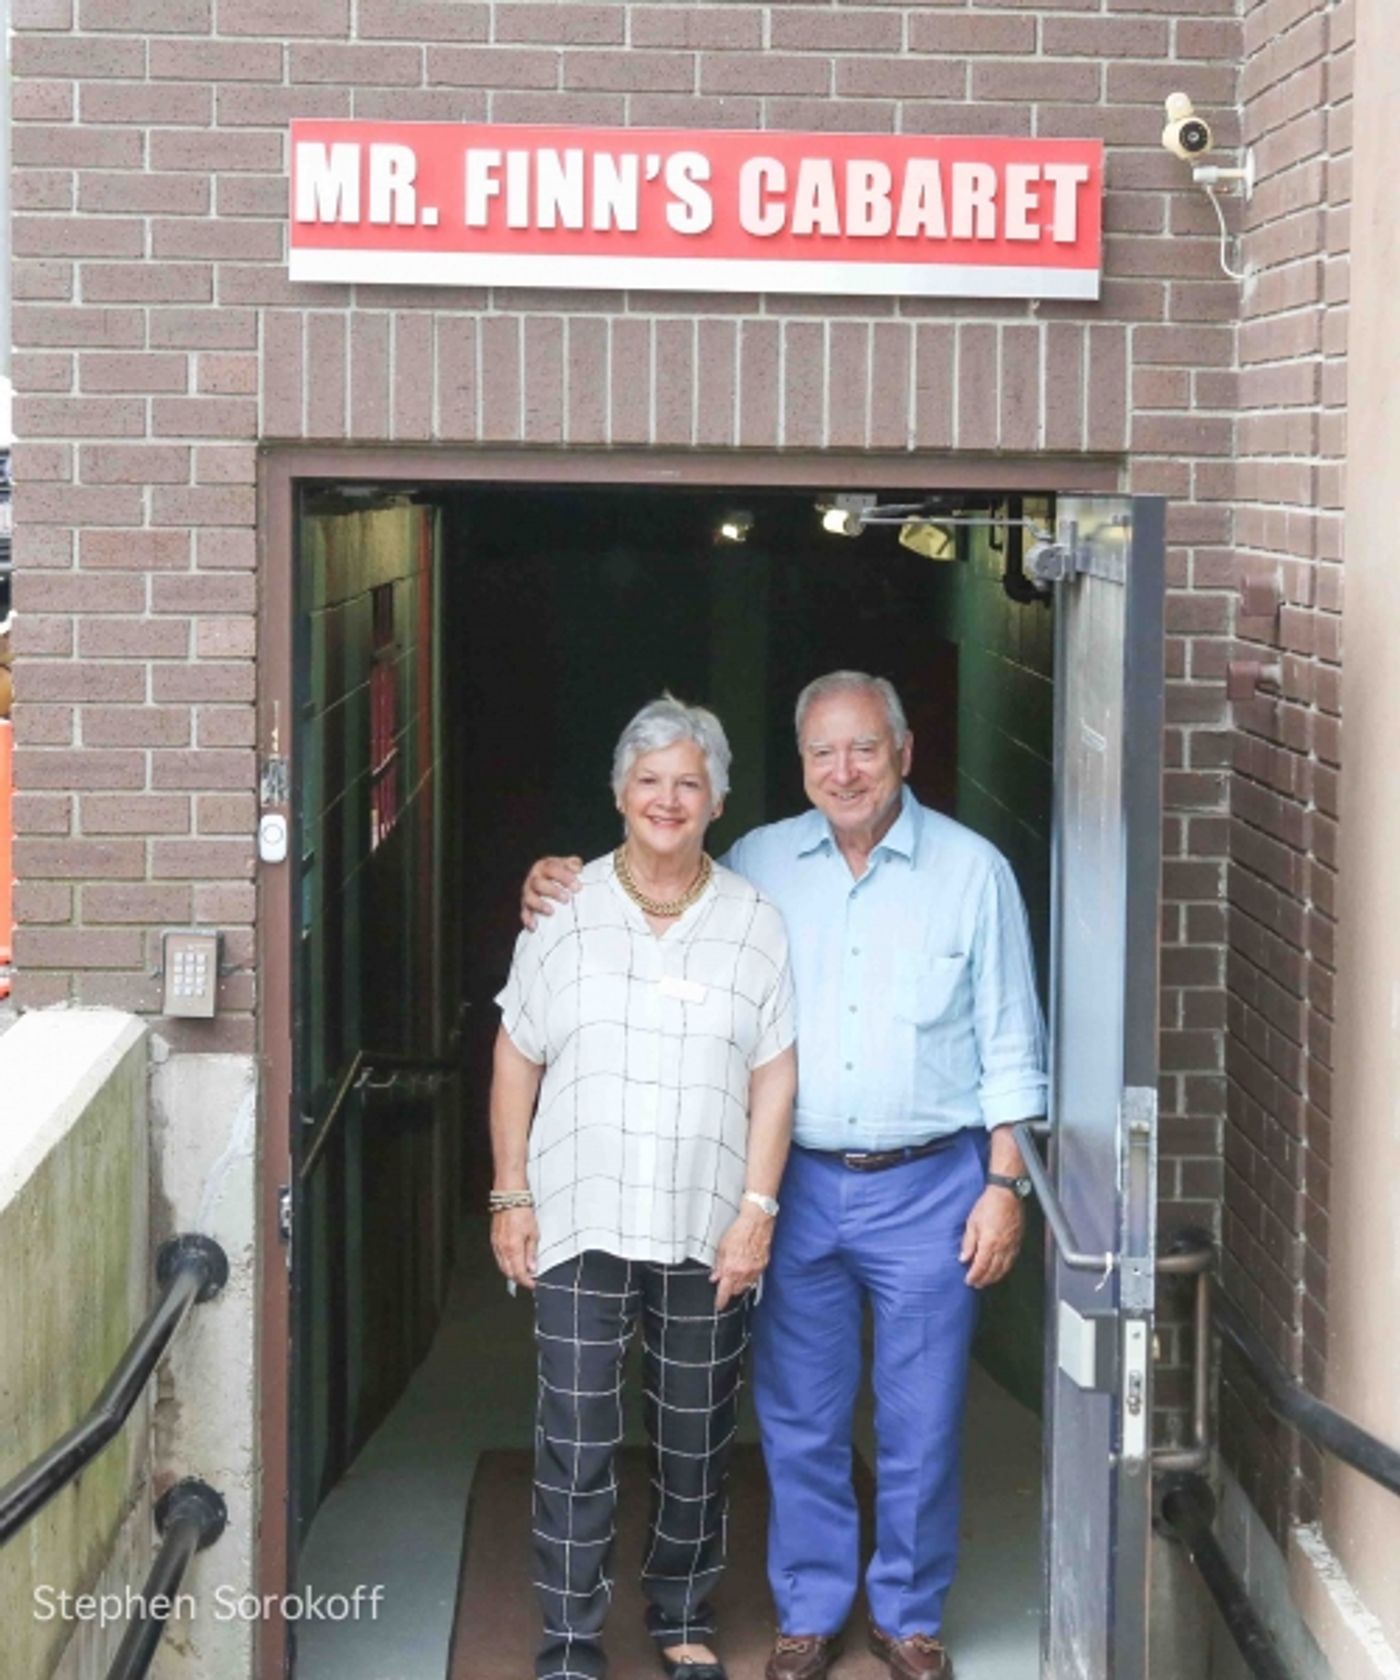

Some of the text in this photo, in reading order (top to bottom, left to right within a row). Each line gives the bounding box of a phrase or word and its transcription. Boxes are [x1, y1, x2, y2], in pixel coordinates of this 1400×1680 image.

[294, 142, 1090, 243] MR. FINN'S CABARET
